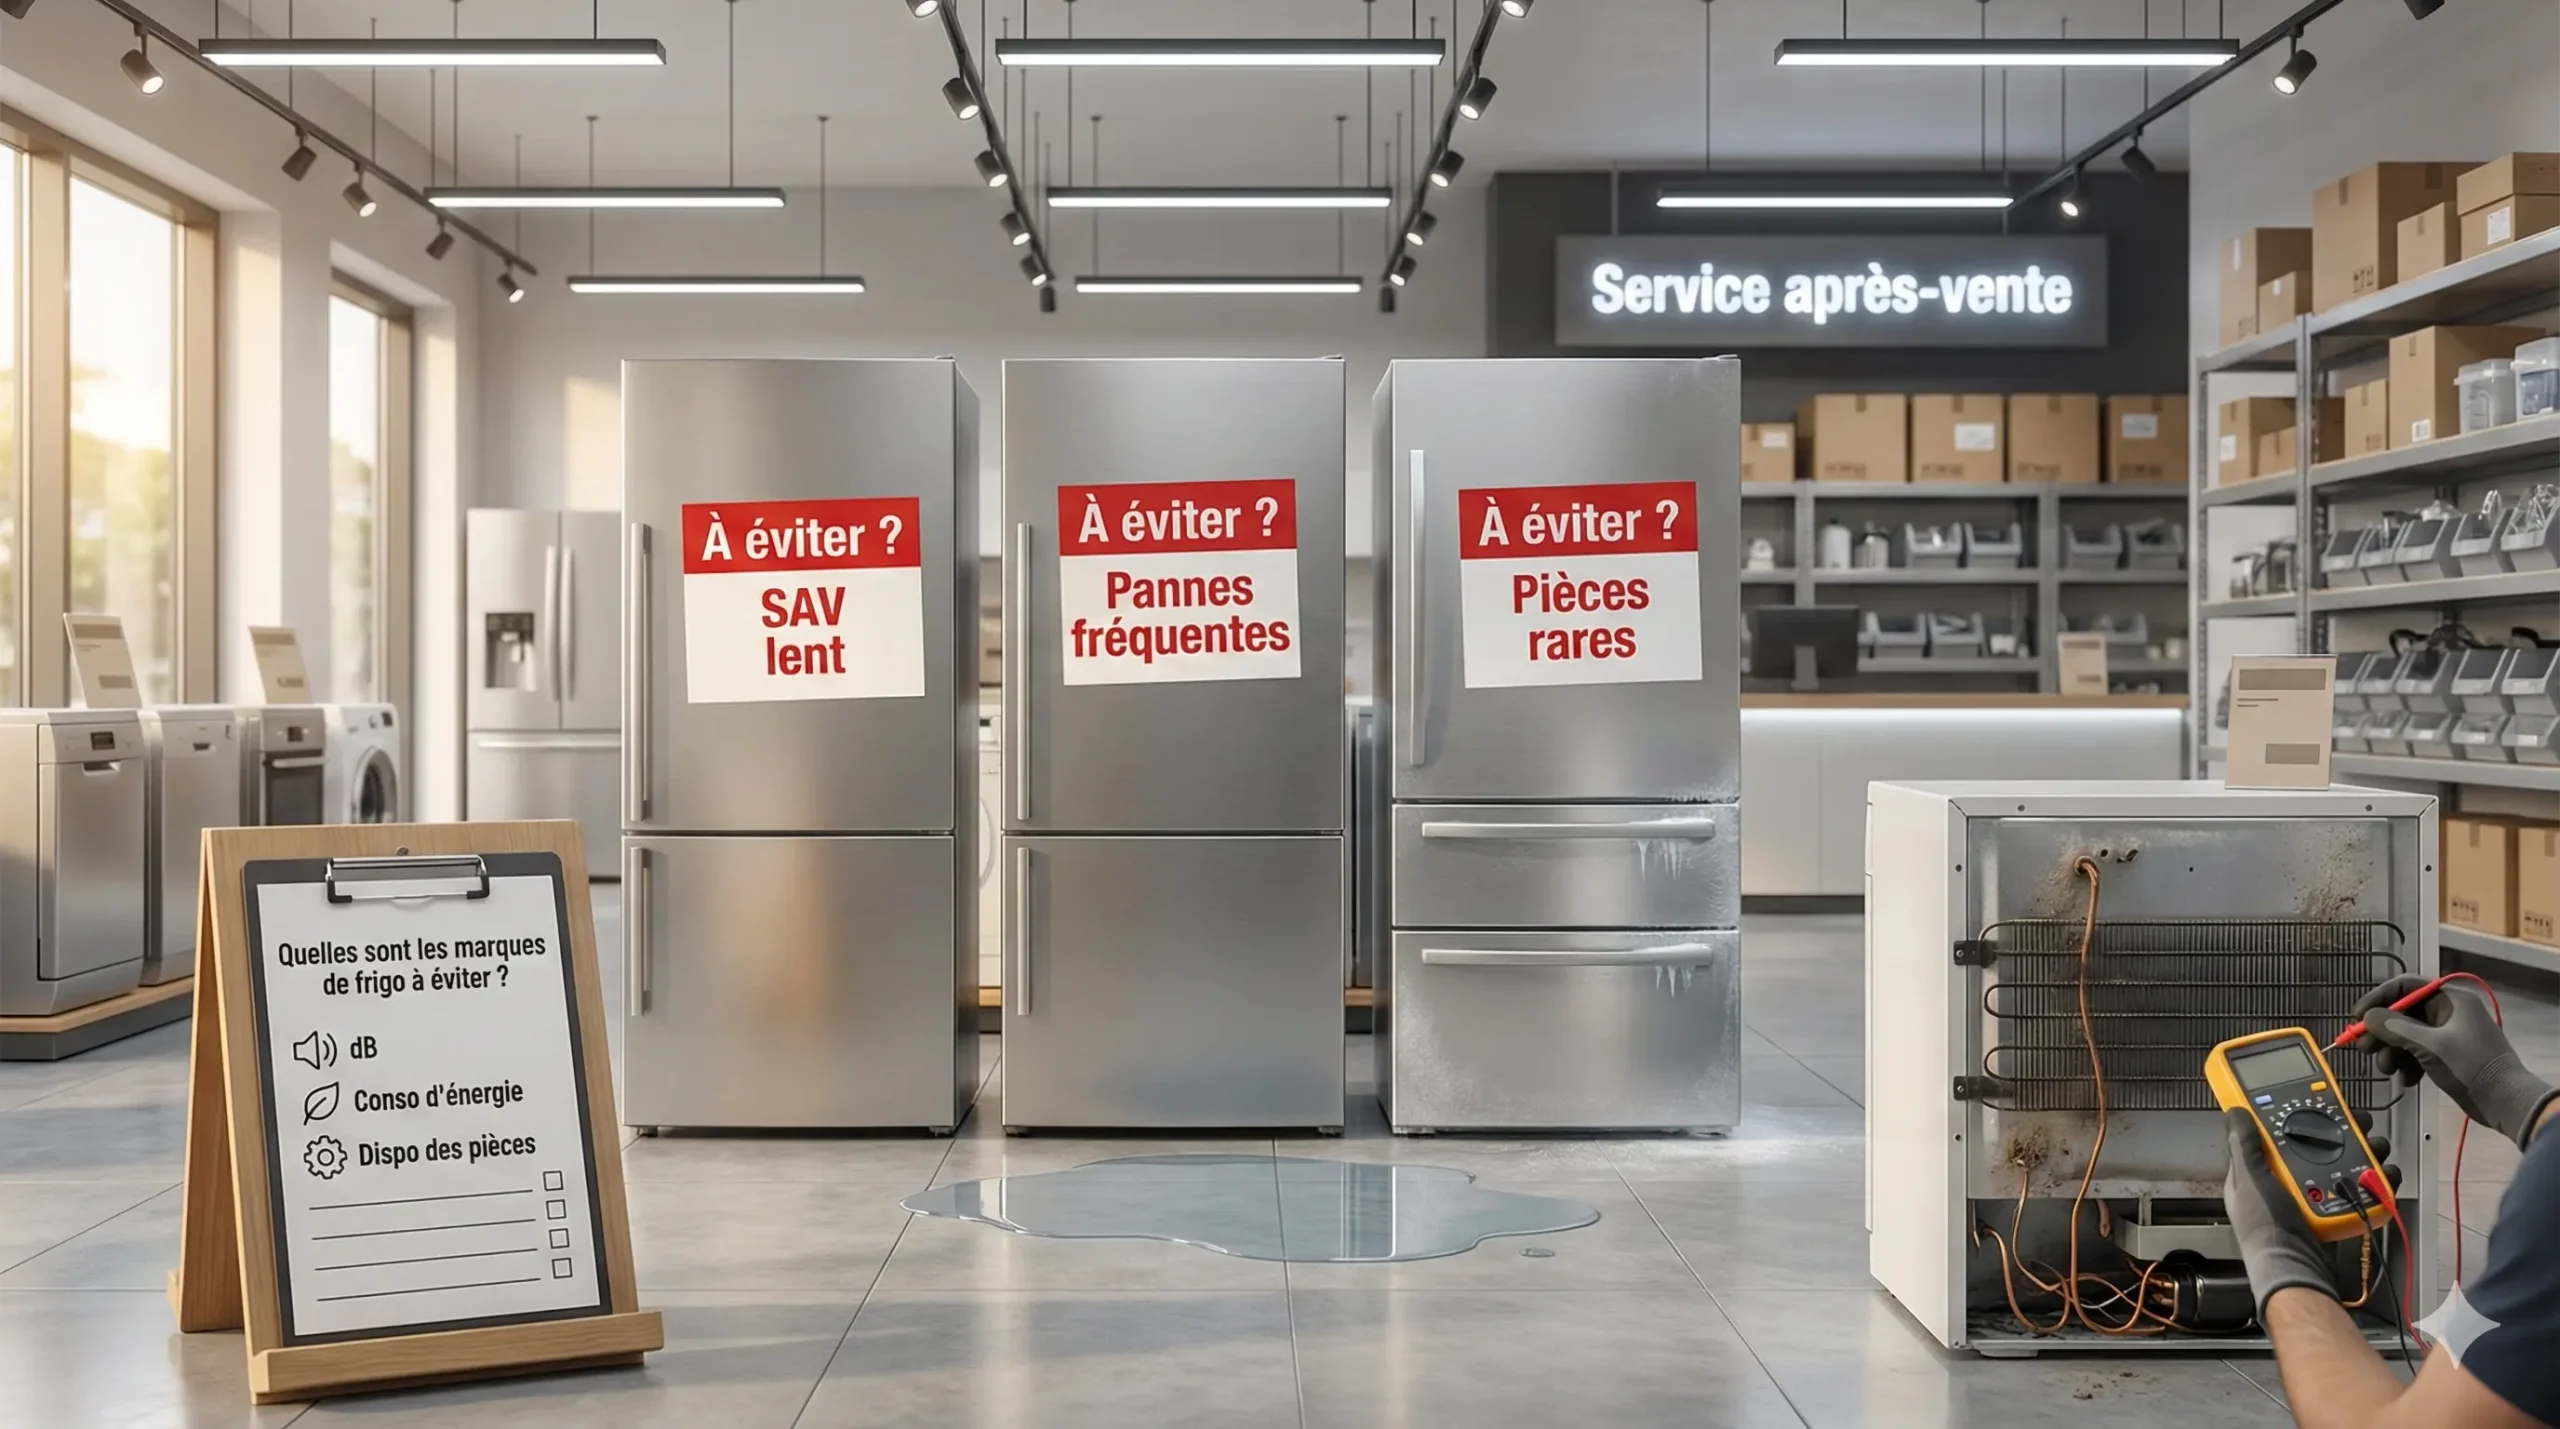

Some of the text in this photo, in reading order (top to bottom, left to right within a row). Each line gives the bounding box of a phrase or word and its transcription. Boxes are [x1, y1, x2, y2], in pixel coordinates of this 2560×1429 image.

[1591, 262, 2073, 325] Service après-vente
[702, 511, 902, 561] À éviter ?
[1078, 493, 1279, 543] À éviter ?
[1479, 496, 1679, 546] À éviter ?
[761, 586, 847, 628] SAV
[1107, 571, 1254, 609] Pannes
[1513, 571, 1650, 614] Pièces
[766, 636, 847, 676] lent
[1071, 615, 1290, 664] fréquentes
[1528, 626, 1637, 661] rares
[277, 937, 546, 967] Quelles sont les marques
[322, 965, 509, 999] de frigo à éviter ?
[350, 1035, 378, 1060] dB
[354, 1079, 524, 1113] Conso d'énergie
[358, 1132, 537, 1170] Dispo des pièces
